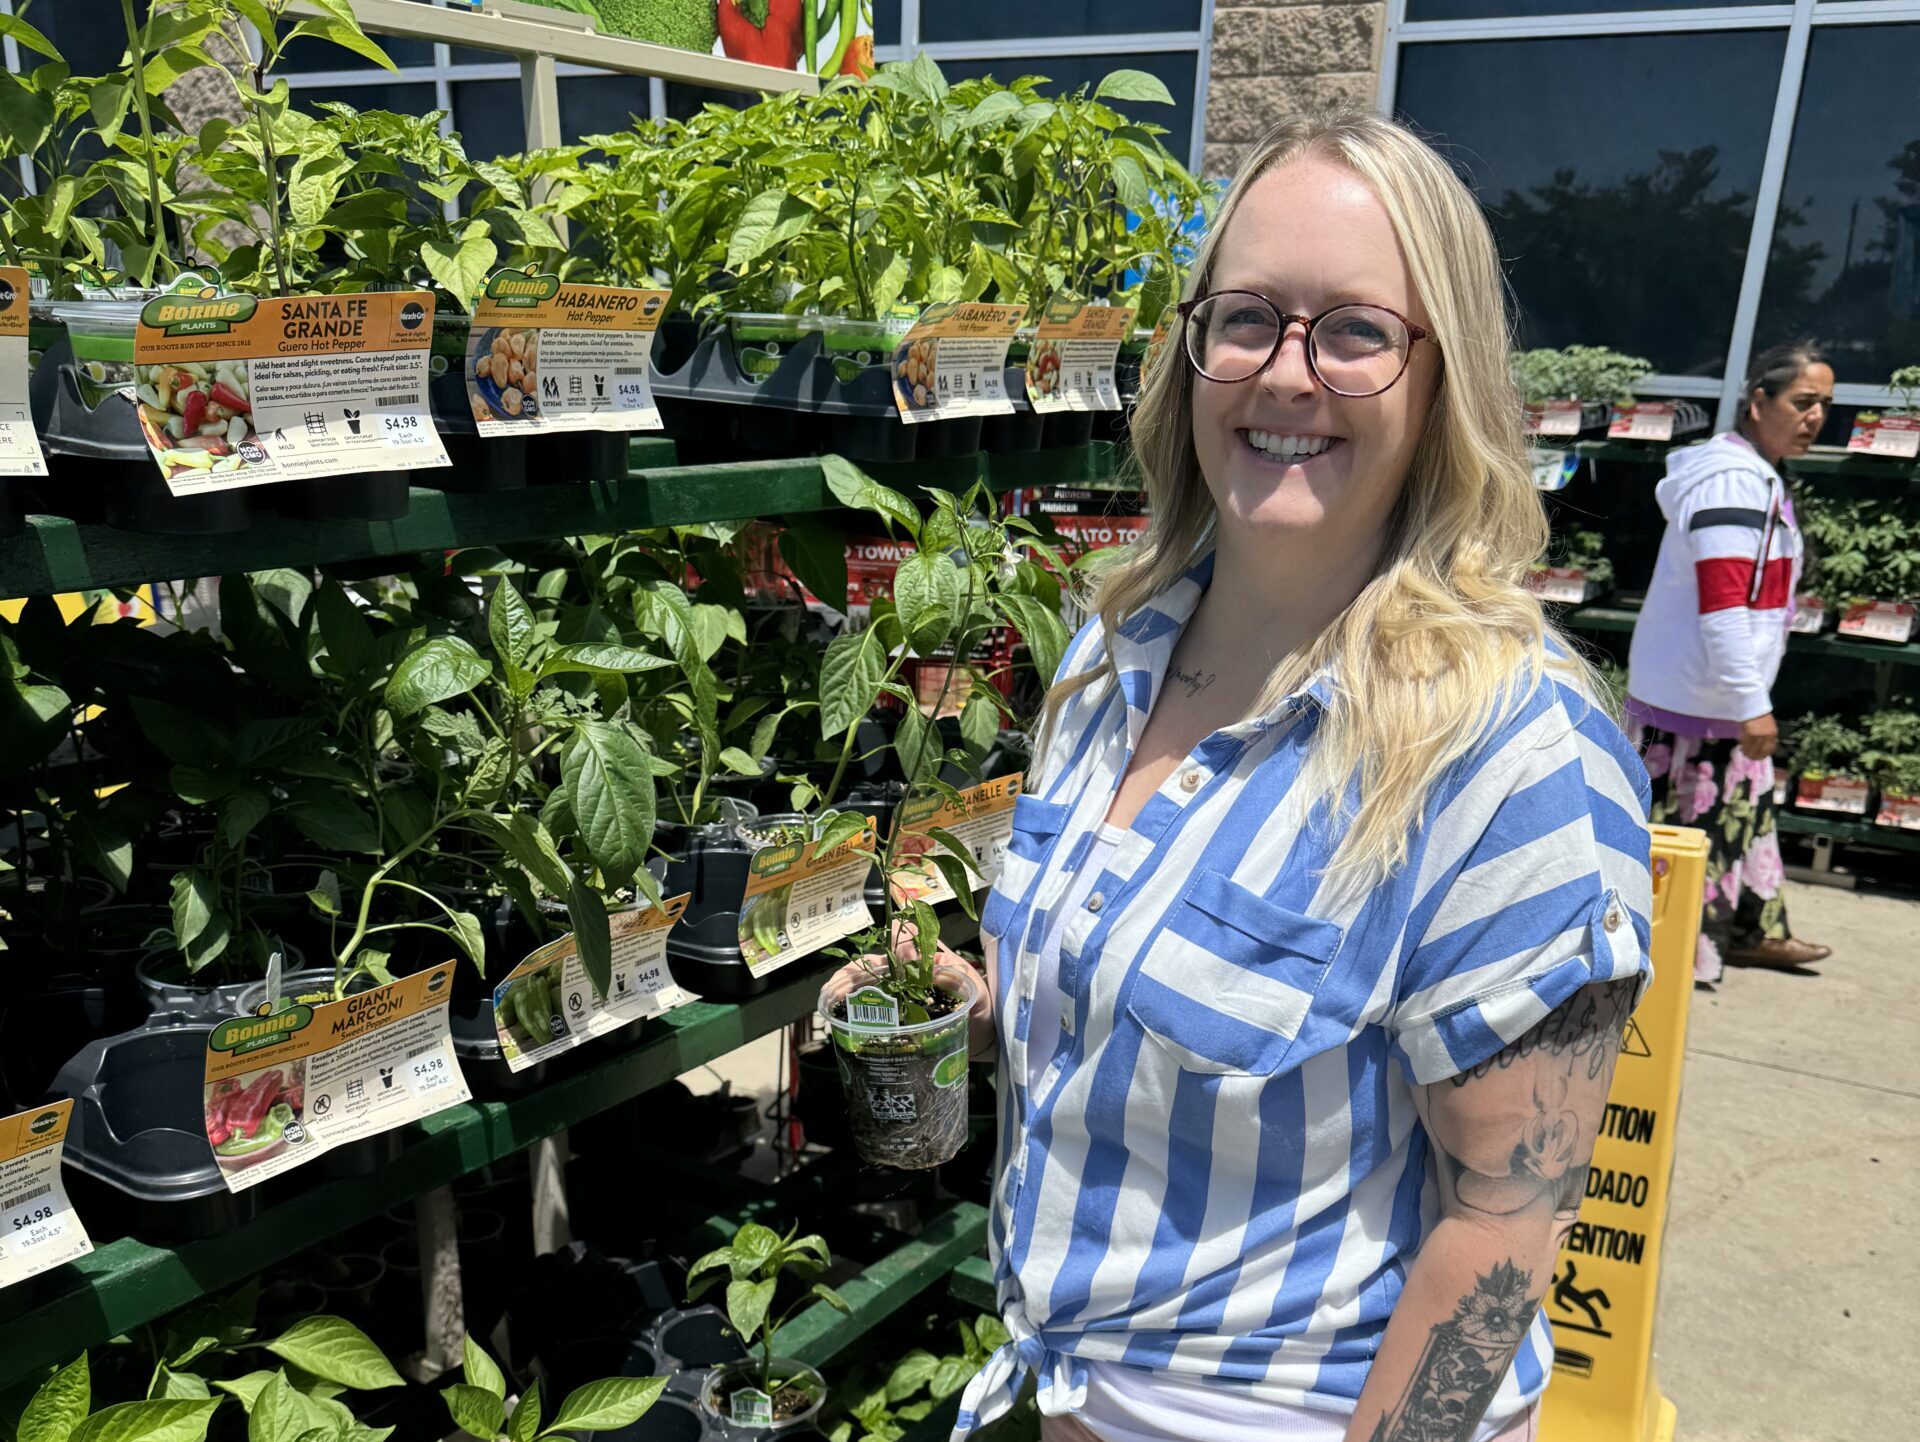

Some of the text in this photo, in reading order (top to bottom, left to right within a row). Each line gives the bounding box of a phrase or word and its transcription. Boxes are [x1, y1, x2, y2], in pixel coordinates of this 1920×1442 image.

[496, 279, 549, 295] Bonnie
[555, 292, 639, 311] HABANERO
[158, 302, 240, 321] Bonnie
[281, 300, 367, 320] SANTA FE
[567, 311, 616, 325] Hot Pepper
[181, 322, 216, 330] PLANTS
[283, 320, 363, 339] GRANDE
[156, 343, 179, 351] ROOTS
[180, 342, 194, 350] RUN
[278, 339, 366, 352] Guero Hot Pepper
[254, 362, 269, 370] Mild
[271, 361, 286, 369] heat
[287, 360, 300, 368] and
[301, 359, 319, 368] slight
[320, 358, 354, 366] sweetness.
[372, 354, 395, 363] shaped
[395, 354, 409, 362] pods
[272, 371, 282, 379] for
[283, 371, 304, 379] salsas,
[305, 369, 332, 378] pickling,
[341, 367, 360, 375] eating
[316, 390, 327, 398] para
[619, 384, 641, 395] $4.98
[385, 416, 418, 430] $4.98
[240, 446, 260, 454] NON
[244, 451, 262, 459] GMO
[282, 457, 339, 468] bonnieplants.com
[758, 847, 796, 868] Bonnie
[639, 968, 660, 982] $4.98
[346, 986, 394, 1014] GIANT
[331, 996, 404, 1035] MARCONI
[225, 1013, 298, 1045] Bonnie
[340, 1015, 393, 1041] Sweet Pepper
[247, 1034, 279, 1048] PLANTS
[312, 1049, 338, 1063] Excellent
[413, 1059, 444, 1076] $4.98
[425, 1074, 440, 1083] Each
[284, 1124, 301, 1134] NON
[287, 1131, 304, 1141] GMO
[5, 1148, 54, 1171] sweet, smoky
[4, 1165, 30, 1178] winner.
[17, 1172, 34, 1183] dulce
[35, 1165, 51, 1174] sabor
[23, 1177, 41, 1188] 2001.
[1585, 1166, 1649, 1208] DADO
[13, 1206, 53, 1230] $4.98
[30, 1226, 48, 1237] Each
[1561, 1221, 1646, 1265] ENTION
